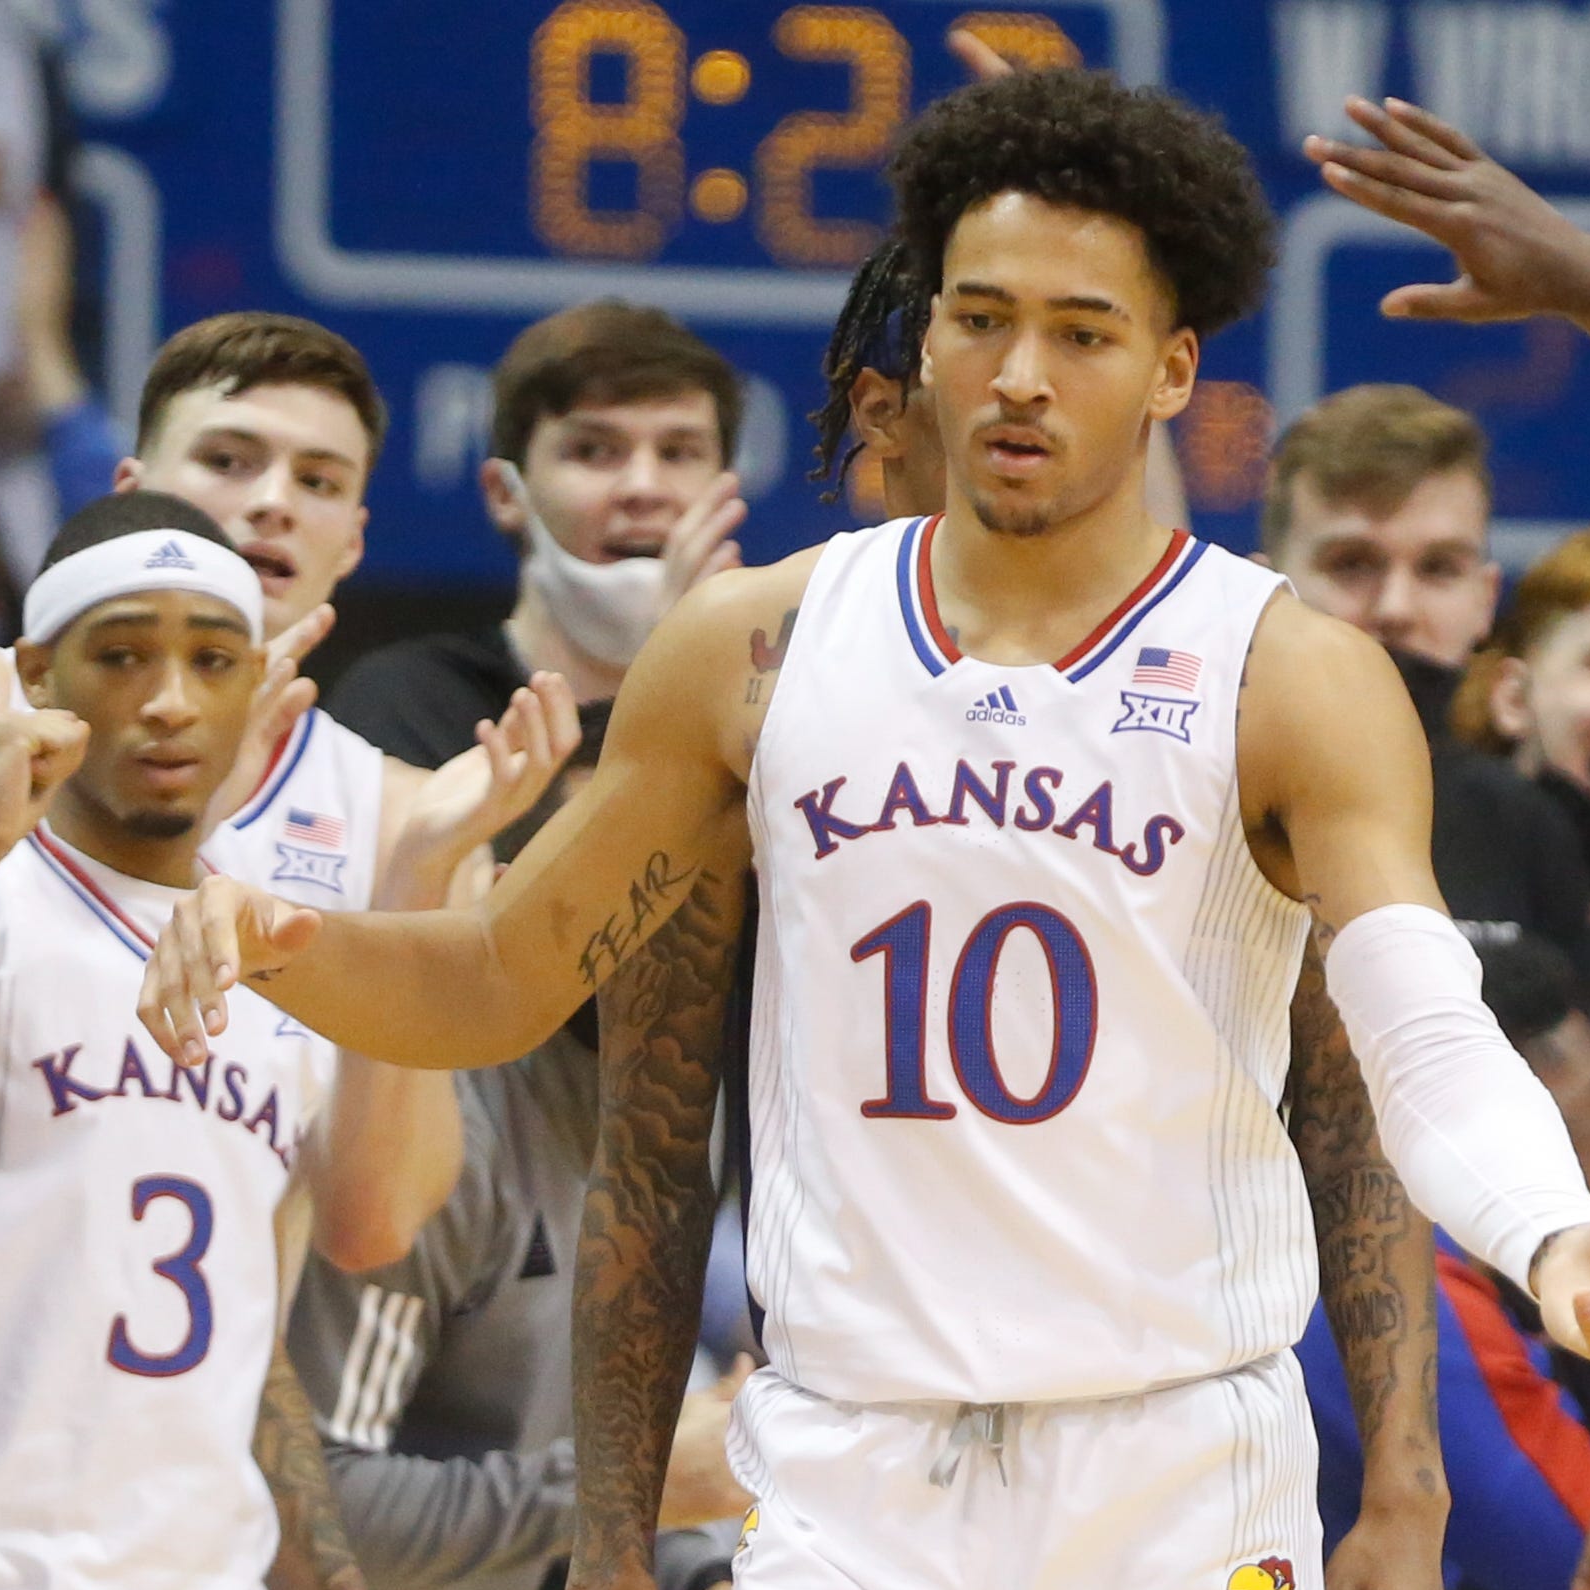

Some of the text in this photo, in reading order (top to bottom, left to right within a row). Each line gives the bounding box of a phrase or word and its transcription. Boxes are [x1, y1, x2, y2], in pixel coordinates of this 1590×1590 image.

[965, 707, 1027, 727] adidas
[793, 759, 1185, 877] KANSAS
[849, 900, 1100, 1126] 10
[32, 1033, 299, 1173] KANSA
[107, 1171, 214, 1378] 3
